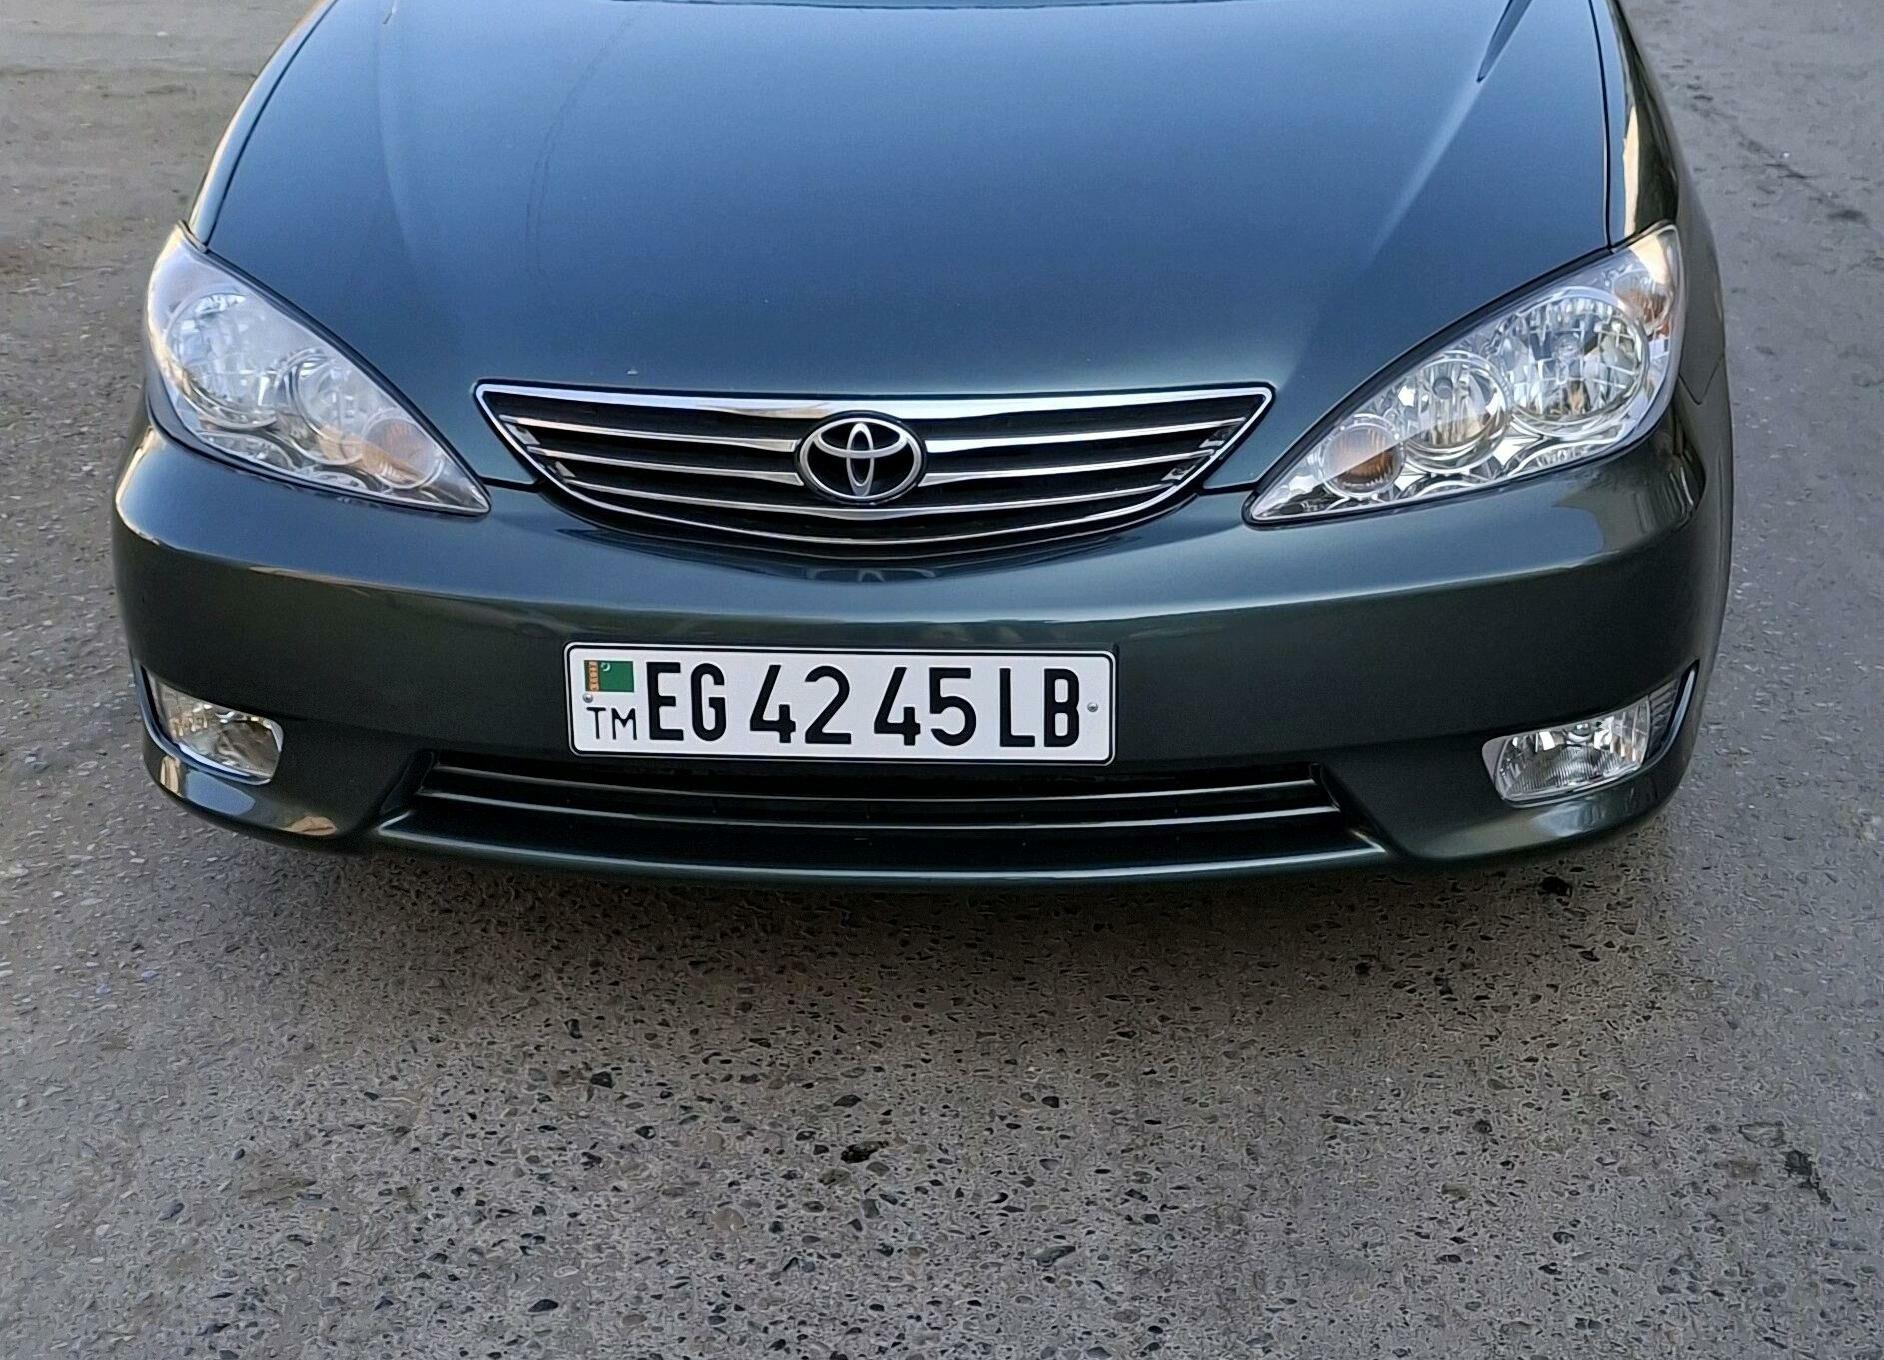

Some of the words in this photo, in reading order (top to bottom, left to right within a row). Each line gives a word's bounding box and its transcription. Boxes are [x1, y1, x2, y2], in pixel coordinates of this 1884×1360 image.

[586, 706, 638, 741] TM
[645, 661, 727, 742] EG
[749, 664, 852, 745] 42
[873, 666, 977, 747] 45
[999, 667, 1080, 748] LB
